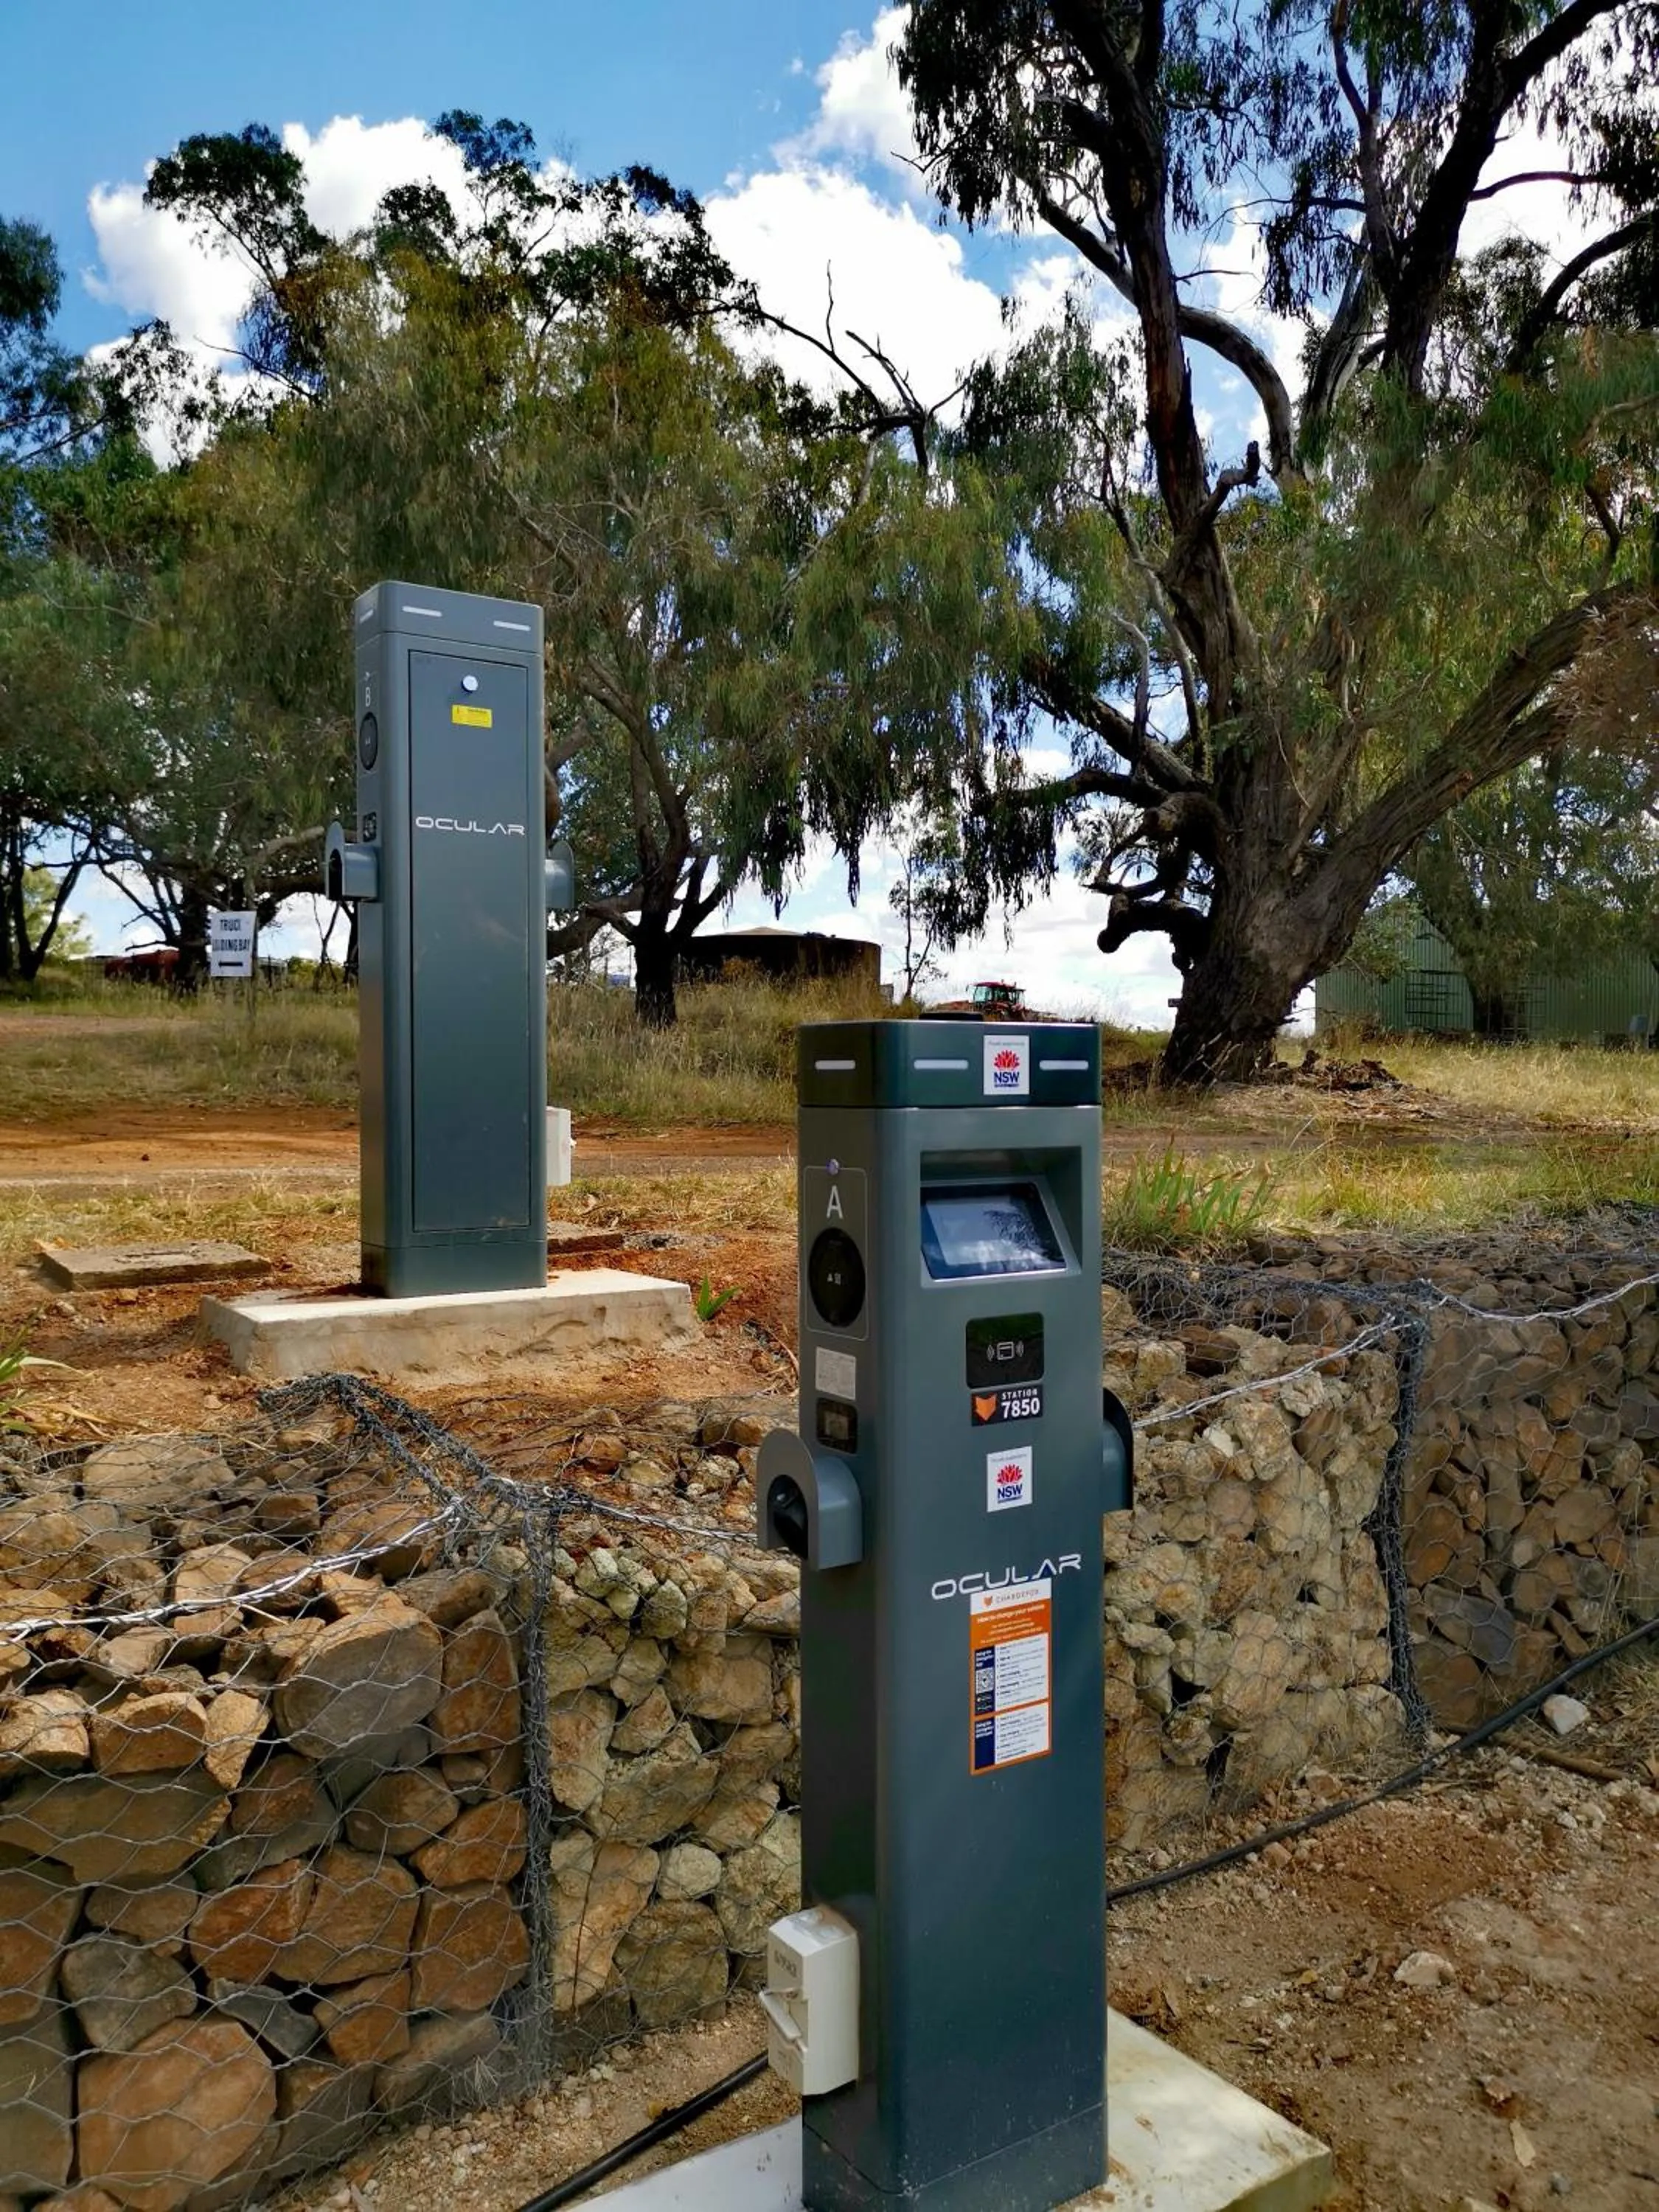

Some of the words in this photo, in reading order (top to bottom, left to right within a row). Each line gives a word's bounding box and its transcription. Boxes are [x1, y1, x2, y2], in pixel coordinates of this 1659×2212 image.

[415, 815, 525, 836] OCULAR
[212, 939, 238, 952] LDING
[993, 1071, 1020, 1083] NSW
[826, 1185, 844, 1219] A
[1002, 1388, 1038, 1400] STATION
[1001, 1397, 1040, 1419] 7850
[998, 1484, 1023, 1499] NSW
[931, 1553, 1082, 1600] OCULAR
